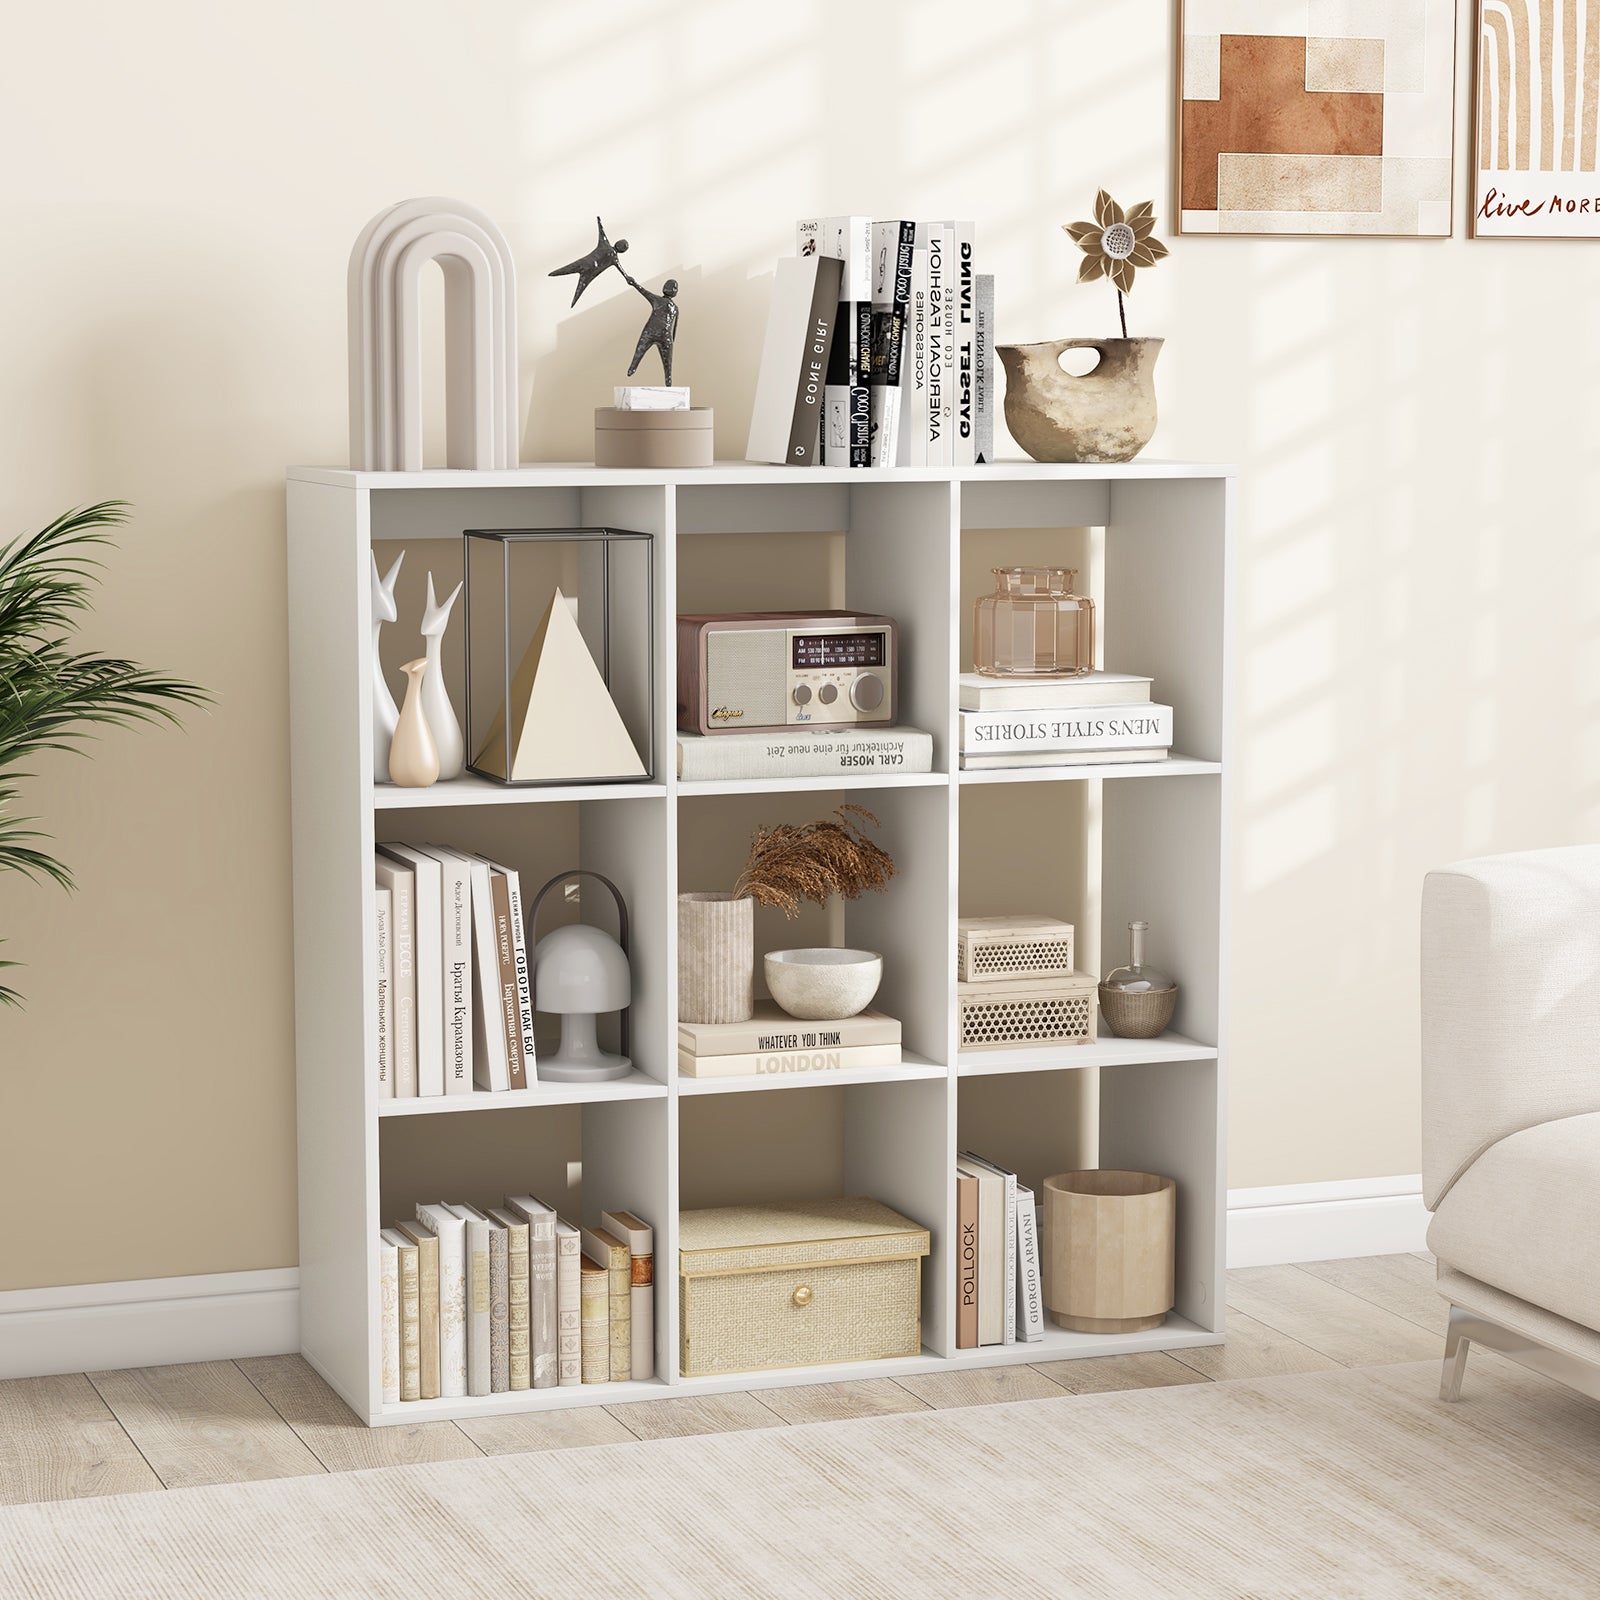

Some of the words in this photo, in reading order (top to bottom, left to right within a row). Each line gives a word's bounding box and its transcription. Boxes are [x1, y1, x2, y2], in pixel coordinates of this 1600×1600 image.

[1477, 187, 1546, 219] live
[1549, 195, 1600, 214] MORE
[974, 723, 1047, 742] STORIES
[1051, 720, 1104, 738] STYLE
[1108, 718, 1160, 736] MEN'S
[766, 746, 785, 758] Zeit
[787, 745, 810, 755] neue
[813, 744, 833, 754] eine
[835, 743, 850, 755] für
[852, 742, 904, 753] Architektur
[840, 755, 875, 766] MOSER
[878, 754, 904, 765] CARL
[399, 933, 412, 978] ГЕССЕ
[450, 962, 466, 1004] Братья
[515, 948, 529, 1005] ГОВОРИ
[378, 979, 388, 1033] Маленькие
[502, 983, 516, 1038] Бархатная
[521, 1009, 532, 1032] КАК
[451, 1006, 467, 1080] Карамазовы
[524, 1036, 534, 1057] БОГ
[758, 1034, 798, 1050] WHATEVER
[801, 1032, 816, 1048] YOU
[819, 1031, 841, 1046] THINK
[378, 1035, 388, 1082] женщины
[507, 1039, 521, 1075] смерть
[756, 1053, 840, 1074] LONDON
[1023, 1213, 1035, 1264] ARMANI
[964, 1223, 974, 1306] POLLOCK
[1026, 1268, 1039, 1324] GIORGIO
